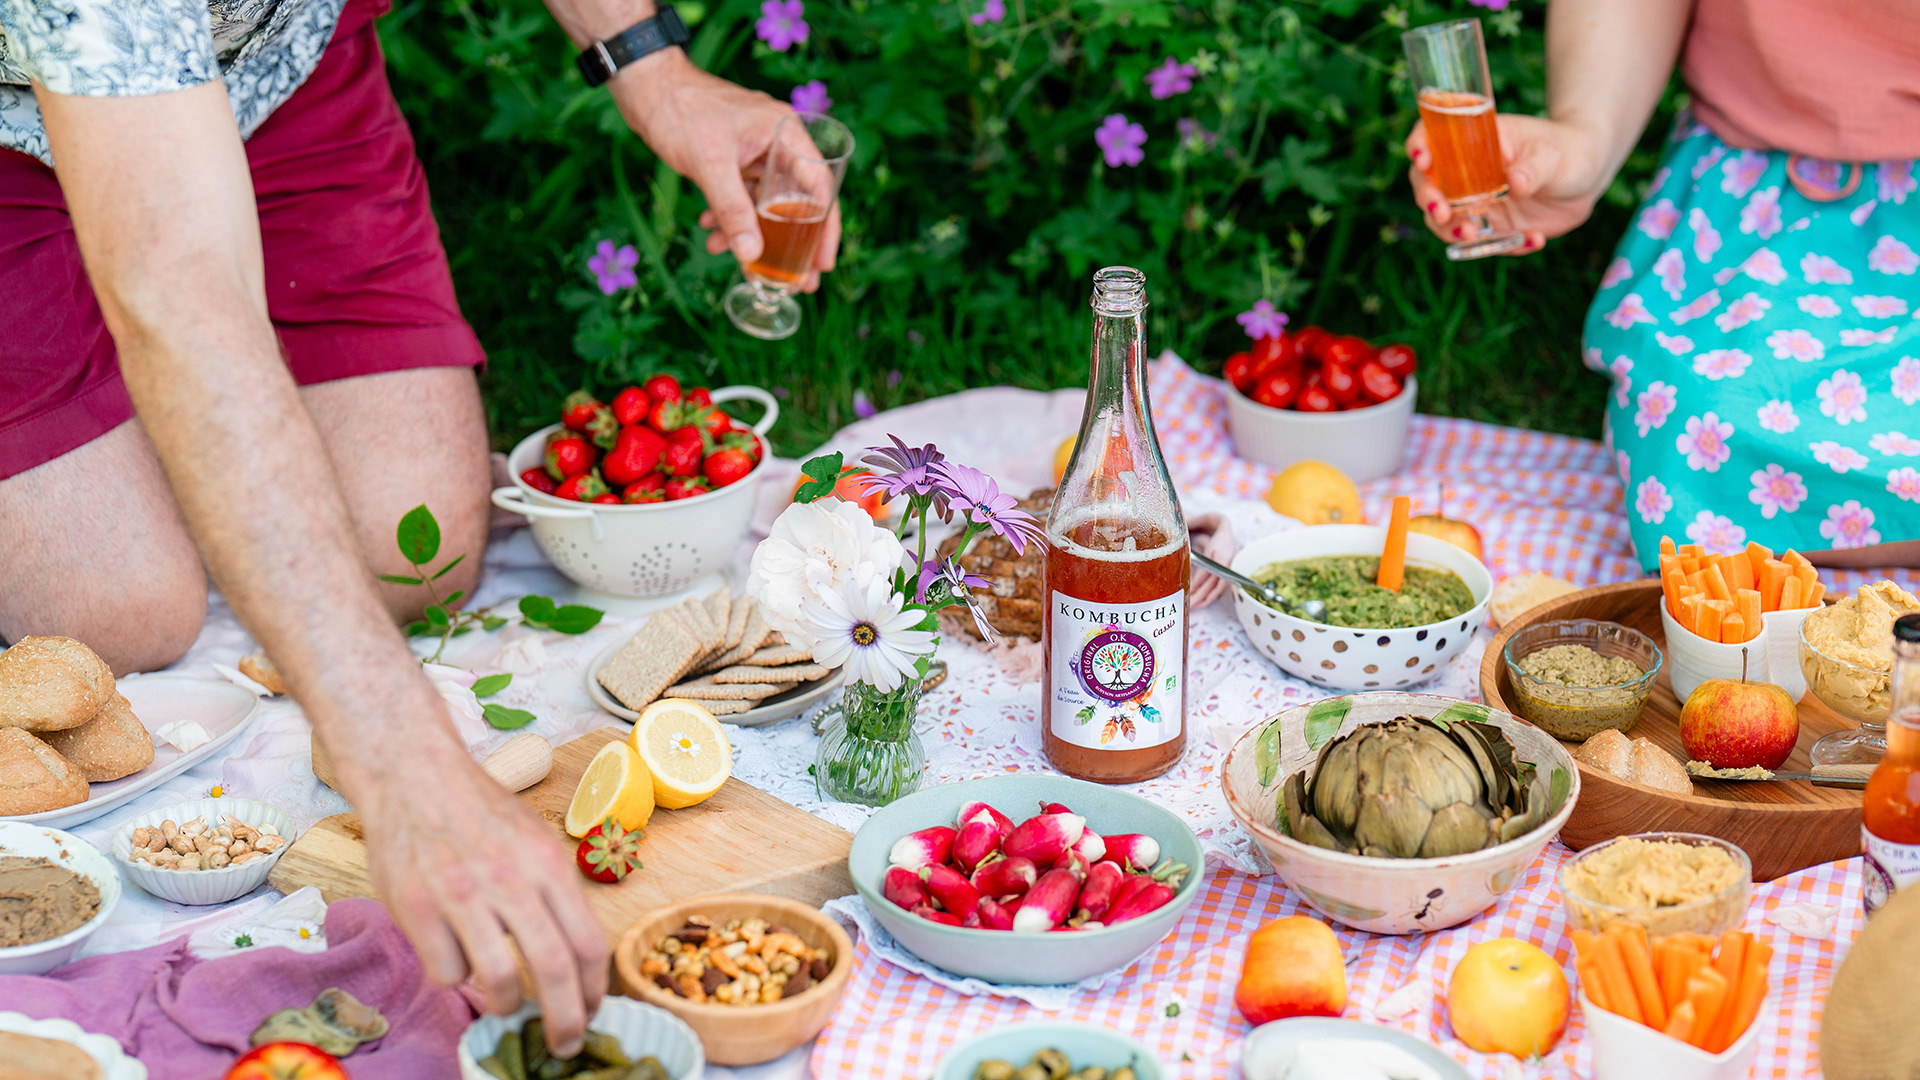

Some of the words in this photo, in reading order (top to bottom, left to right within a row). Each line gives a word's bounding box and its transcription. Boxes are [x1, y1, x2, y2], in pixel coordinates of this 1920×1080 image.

[1060, 602, 1177, 624] KOMBUCHA
[1152, 619, 1176, 638] Cassis
[1084, 643, 1100, 680] ORIGINAL
[1137, 641, 1152, 683] KOMBUCHA
